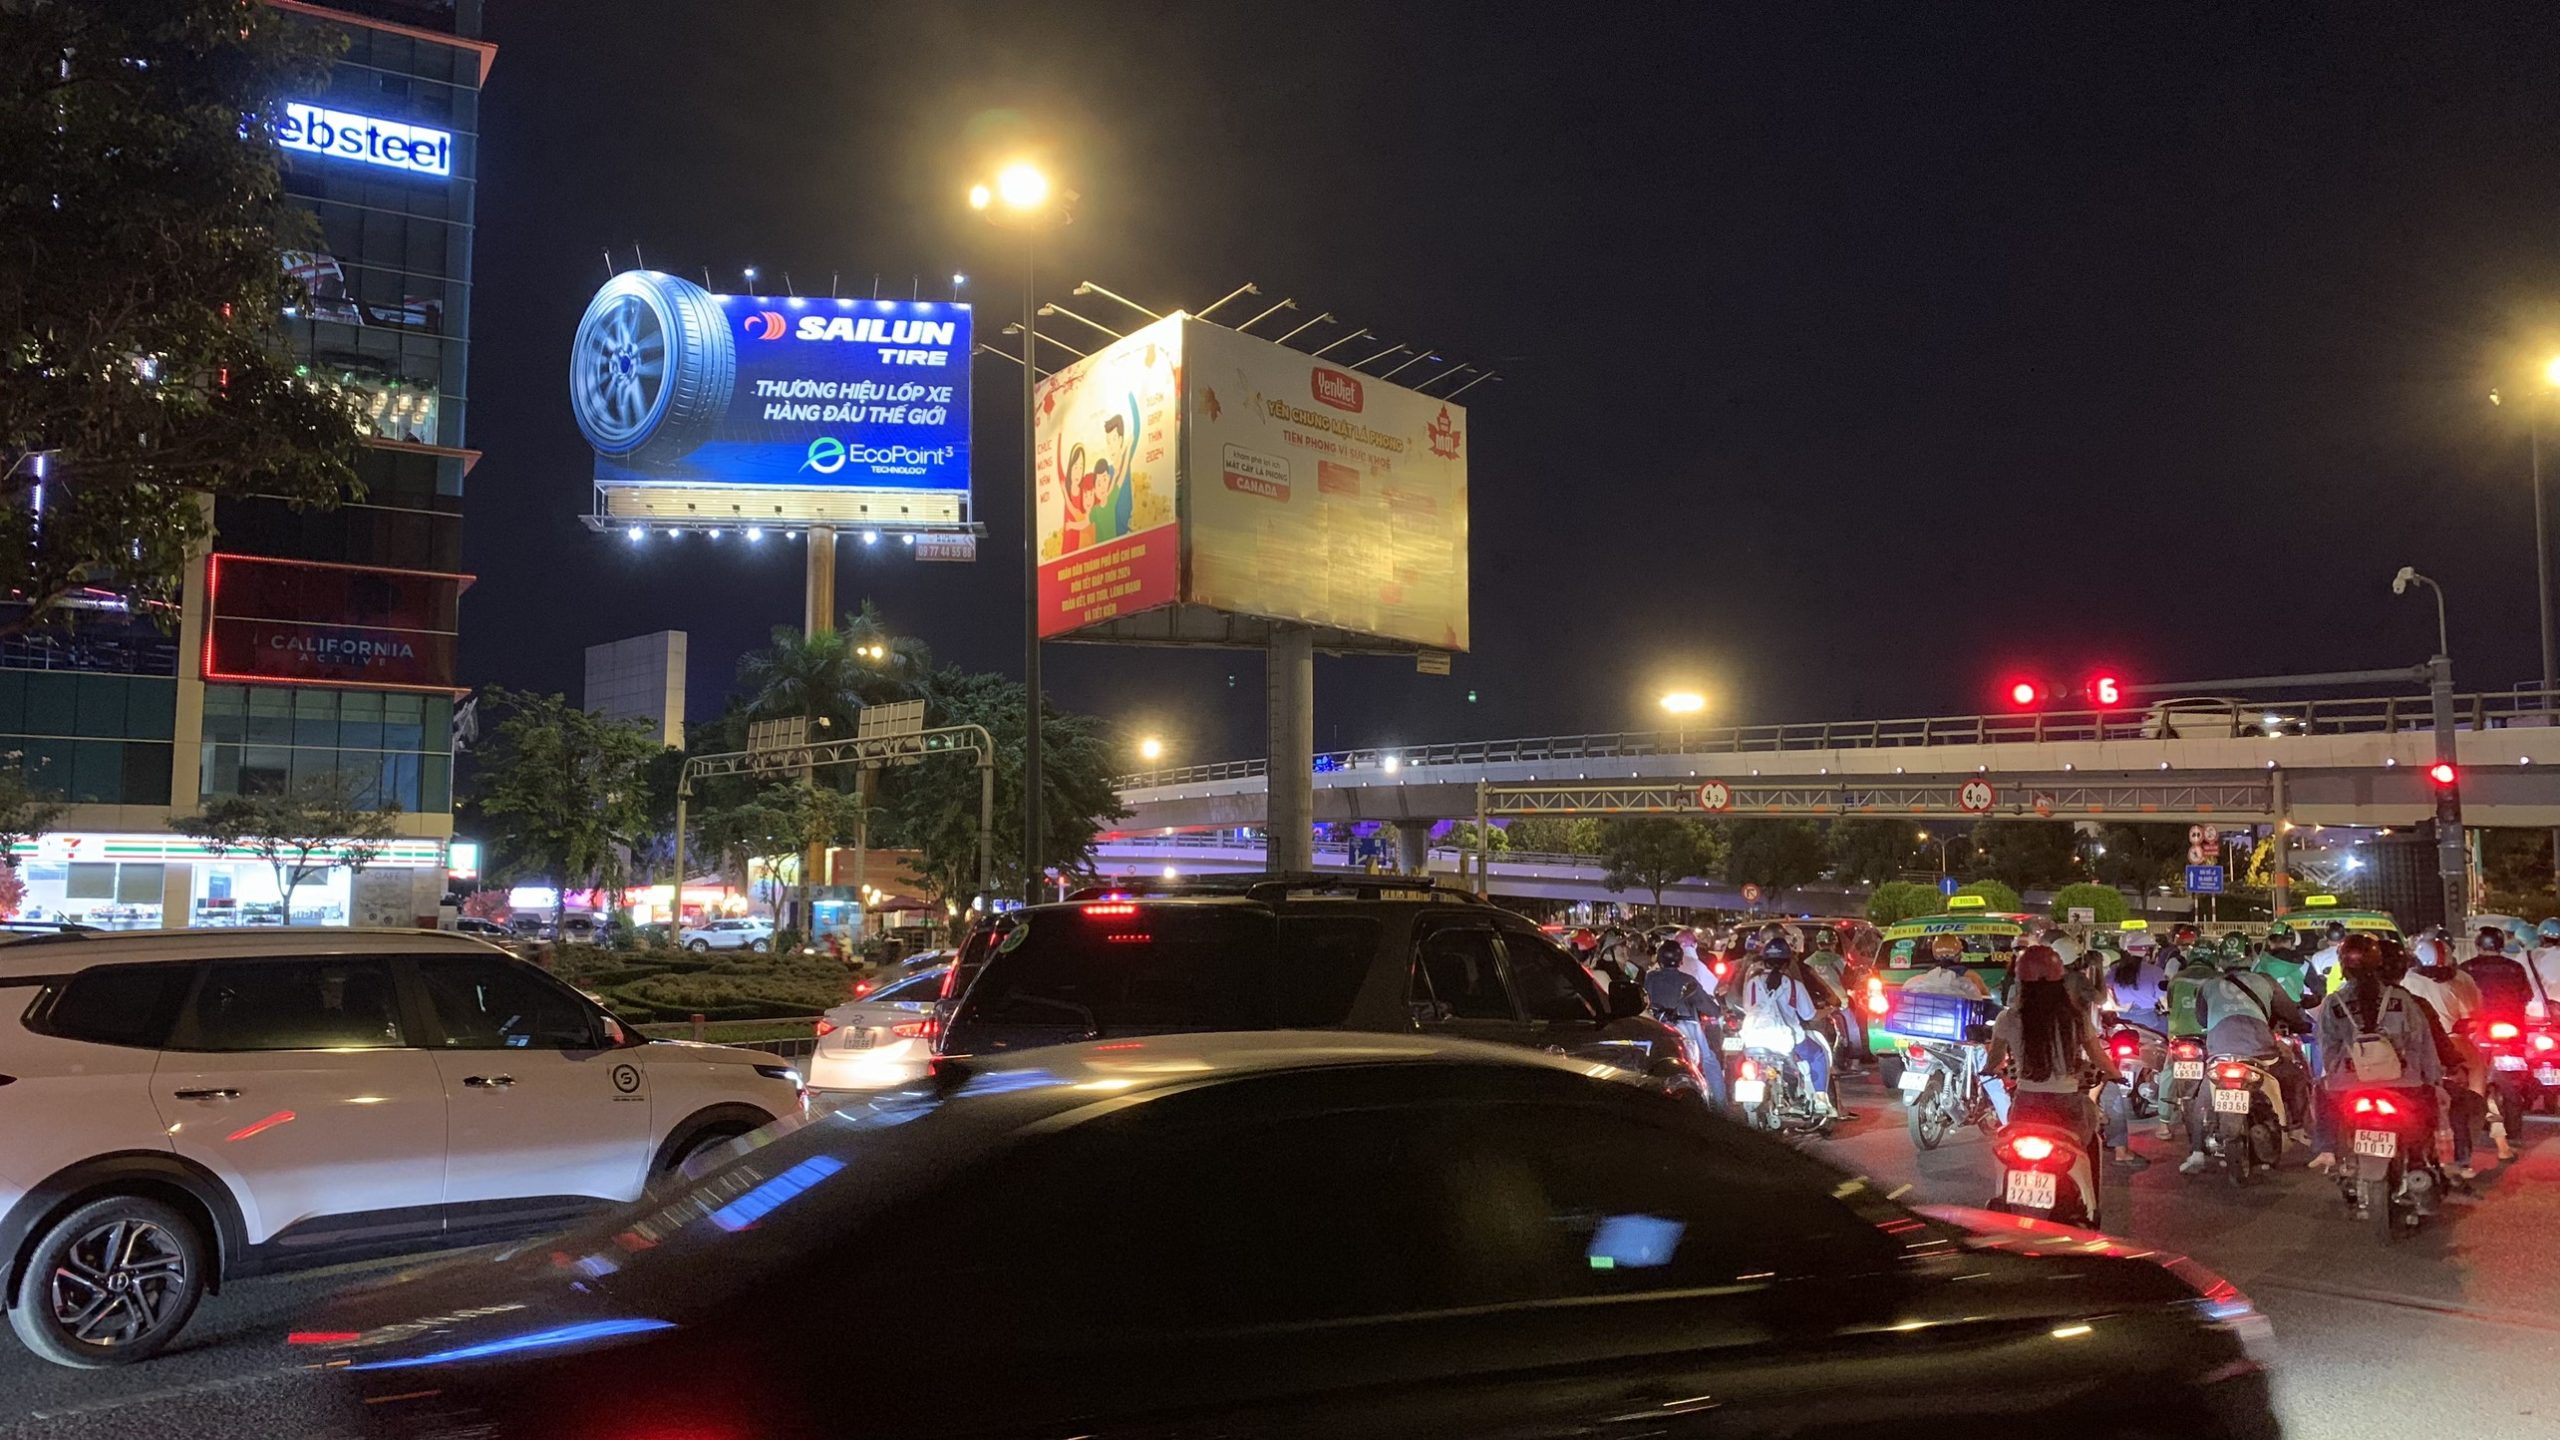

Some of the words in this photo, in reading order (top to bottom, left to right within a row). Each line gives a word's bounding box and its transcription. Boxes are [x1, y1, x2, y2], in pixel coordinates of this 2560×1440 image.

[796, 316, 955, 345] SAILUN
[878, 349, 948, 366] TIRE
[756, 379, 837, 399] THƯƠNG
[838, 379, 885, 403] HIỆU
[887, 381, 926, 402] LỐP
[926, 386, 953, 403] XE
[763, 400, 821, 421] HÀNG
[822, 402, 866, 423] ĐẦU
[868, 404, 909, 424] THẾ
[907, 405, 947, 425] GIỚI
[1267, 399, 1290, 421] YẾN
[1291, 407, 1330, 431] CHƯNG
[1332, 418, 1354, 440] MẬT
[1355, 424, 1369, 443] LÁ
[1369, 431, 1404, 453] PHONG
[1305, 435, 1337, 453] PHONG
[870, 465, 927, 475] TECHNOLOGY
[1236, 477, 1278, 497] CANADA
[929, 546, 939, 557] 77
[941, 547, 950, 557] 44
[271, 635, 415, 658] CALIFORNIA
[300, 654, 386, 666] ACTIVE
[1923, 922, 1968, 934] MPE
